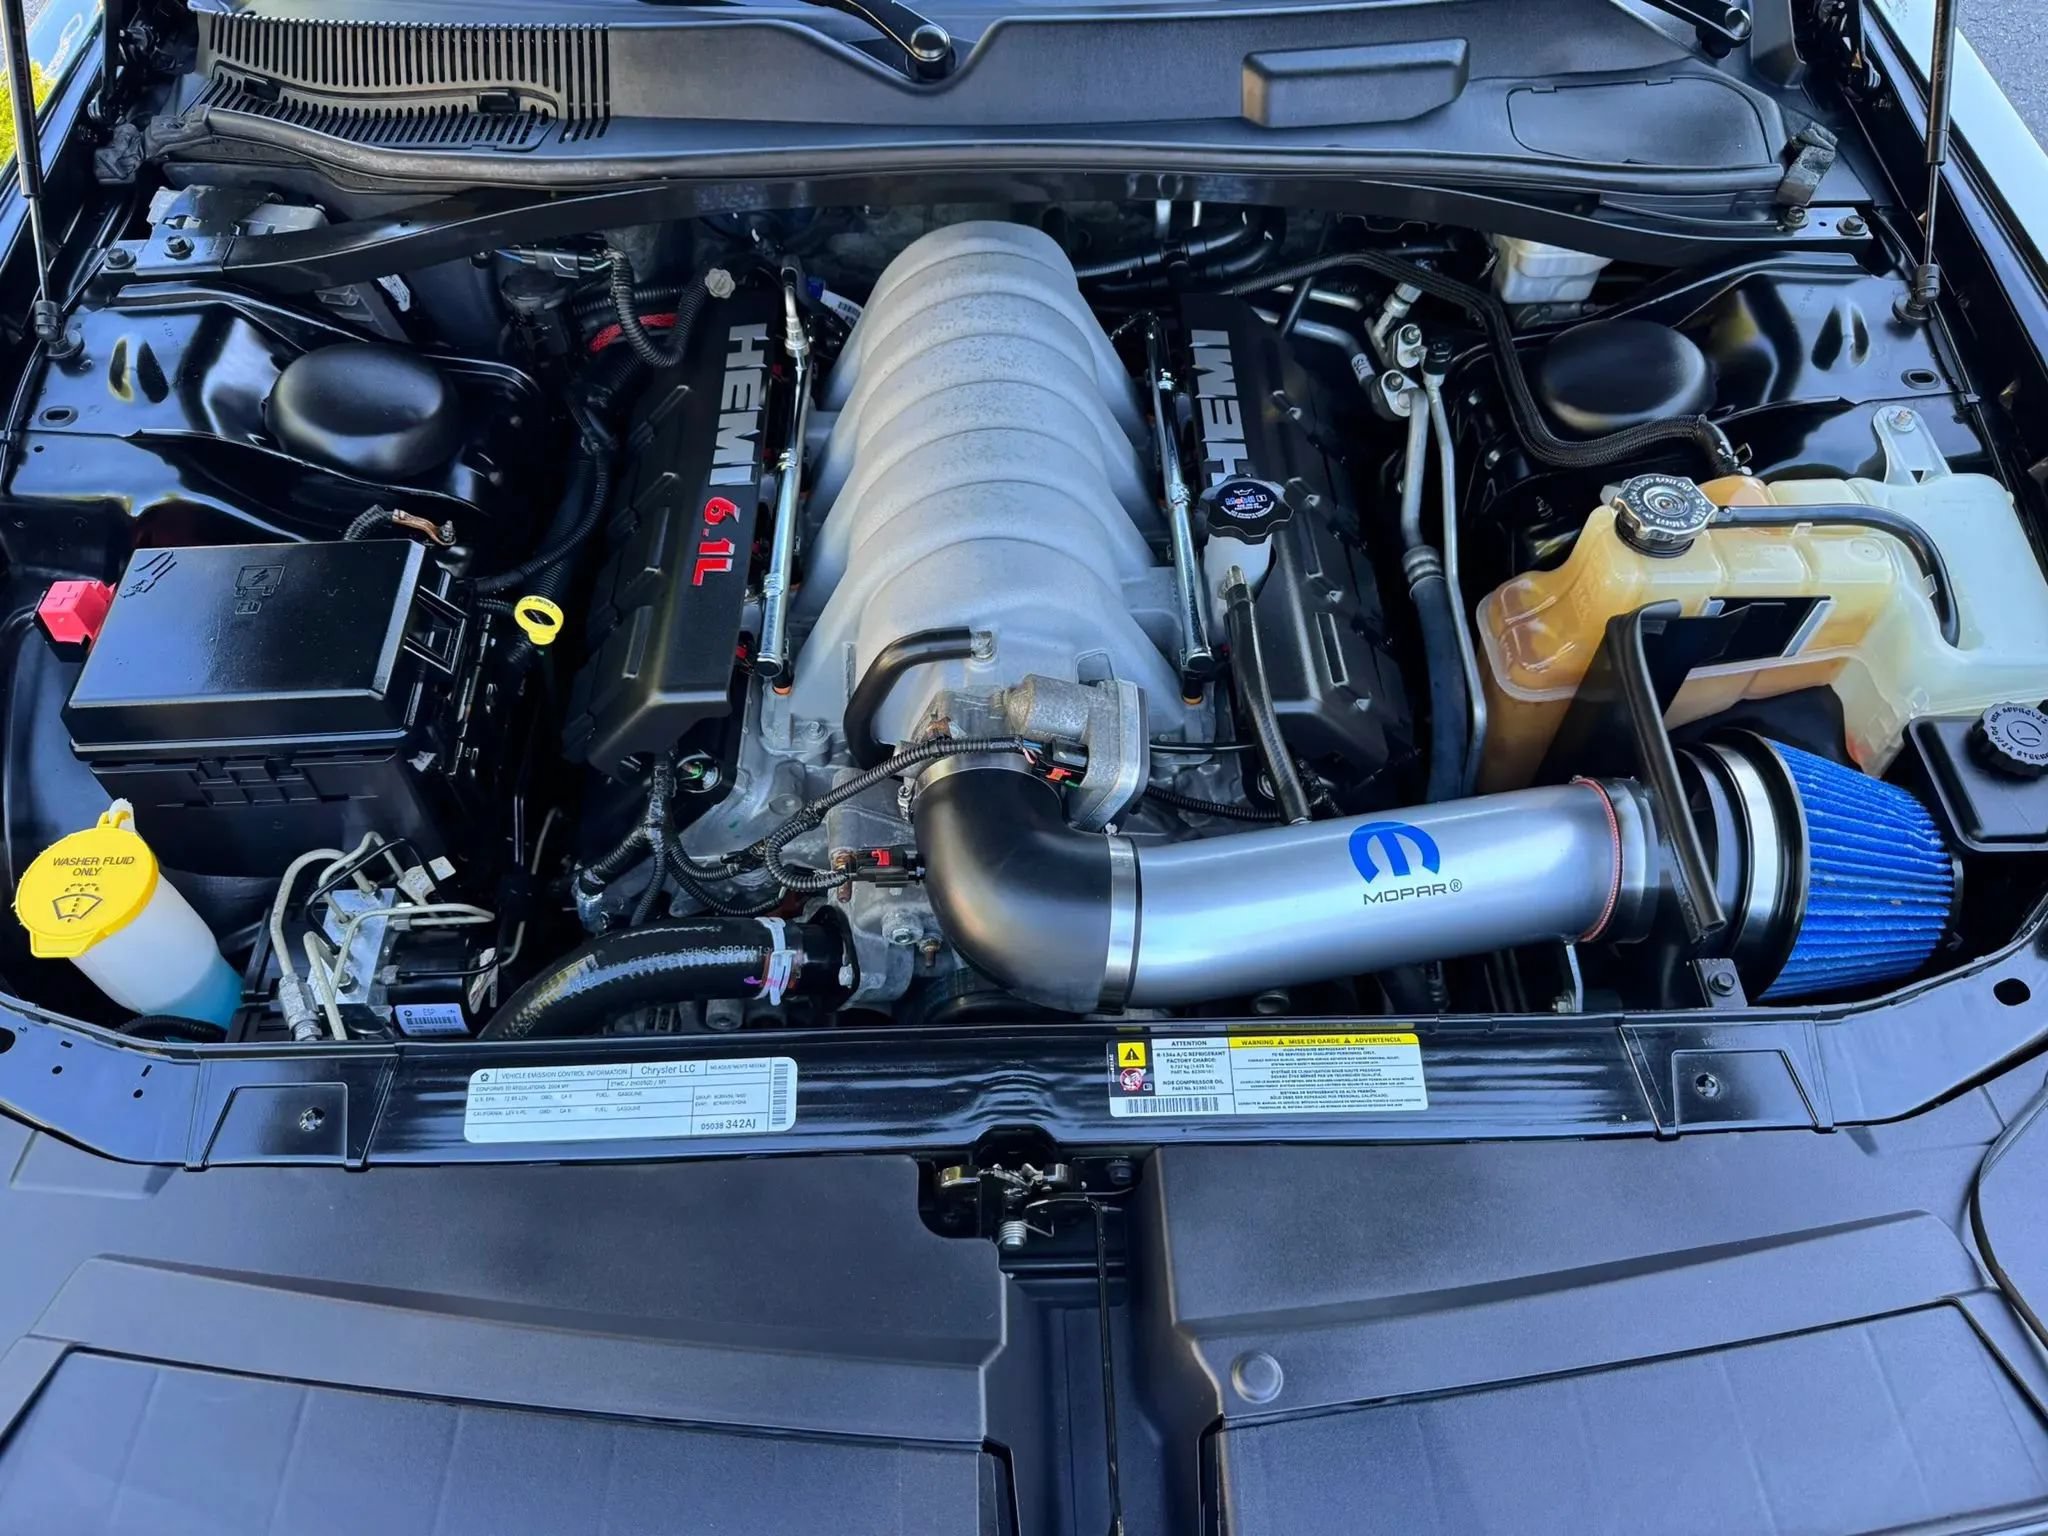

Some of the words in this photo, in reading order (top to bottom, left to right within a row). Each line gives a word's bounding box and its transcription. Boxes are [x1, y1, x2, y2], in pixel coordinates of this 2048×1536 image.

[709, 323, 769, 486] HEMI
[1189, 329, 1249, 487] HEMI
[692, 496, 741, 586] 6.1L
[53, 857, 100, 866] WASHER
[102, 856, 135, 866] FLUID
[72, 867, 102, 877] ONLY
[1241, 1038, 1274, 1046] WARNING
[501, 1072, 526, 1080] VEHICLE
[527, 1071, 556, 1079] EMISSION
[558, 1070, 585, 1078] CONTROL
[586, 1068, 628, 1077] INFORMATION
[640, 1065, 677, 1076] Chrysler
[679, 1064, 696, 1074] LLC
[701, 1122, 724, 1130] 05038
[725, 1119, 756, 1130] 342AJ
